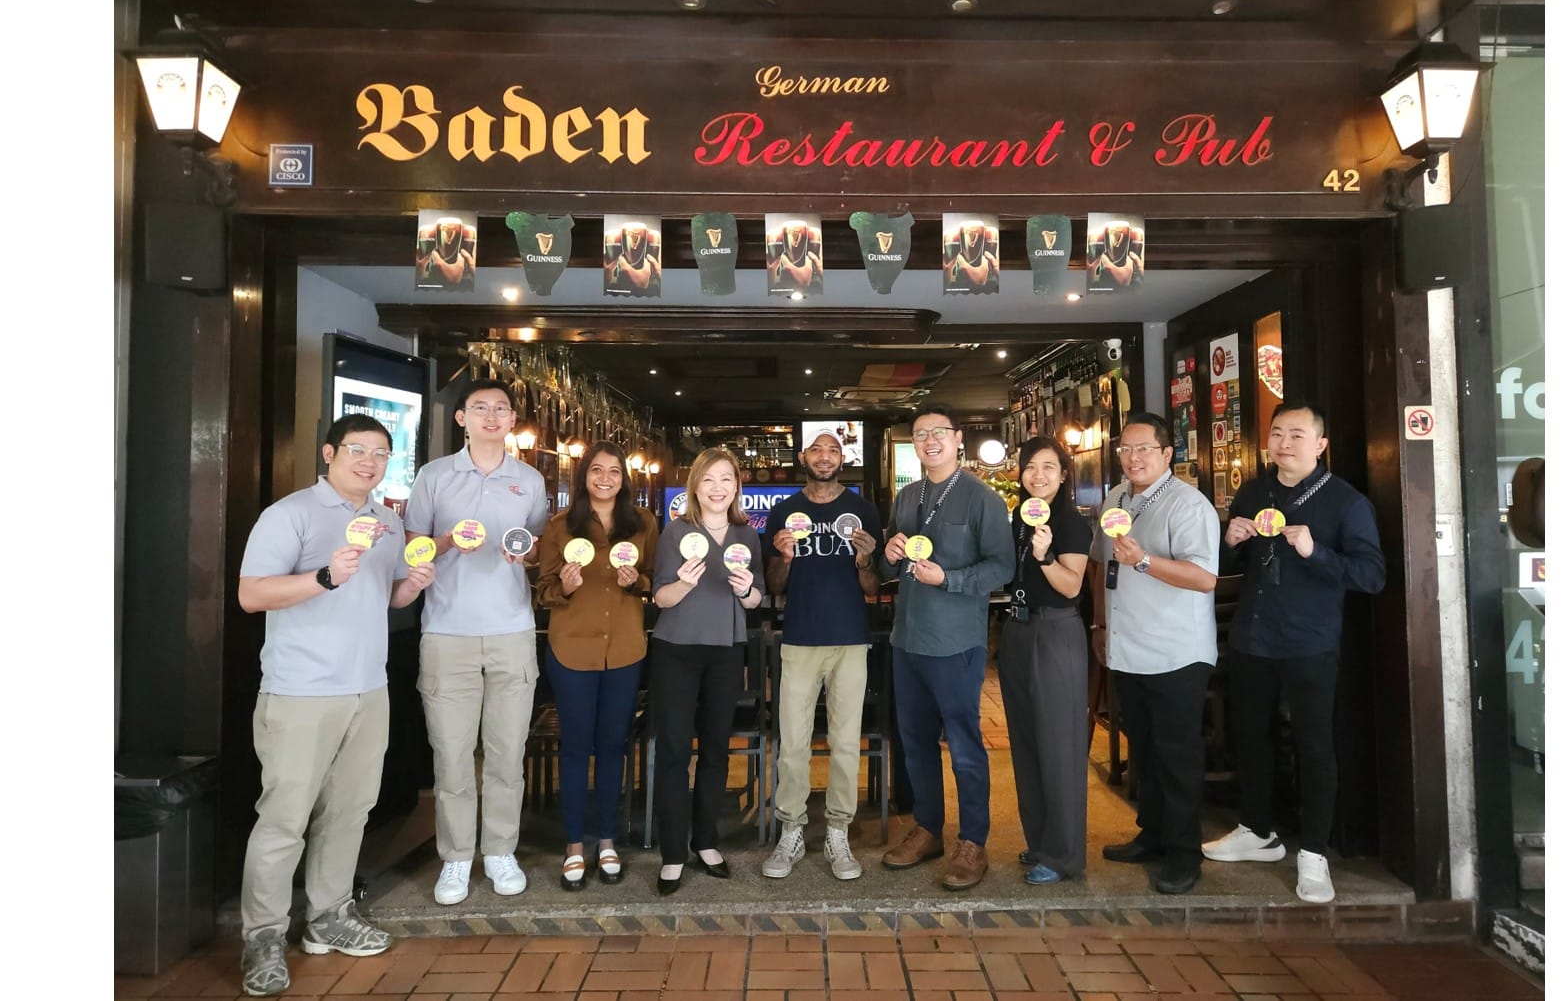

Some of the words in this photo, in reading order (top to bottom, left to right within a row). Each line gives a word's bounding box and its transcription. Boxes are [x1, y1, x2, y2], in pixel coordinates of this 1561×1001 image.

[755, 65, 890, 98] German
[355, 82, 653, 165] Baden
[694, 112, 1066, 168] Restaurant
[1088, 120, 1136, 168] &
[1155, 113, 1275, 167] Pub
[276, 172, 306, 181] CISCO
[1322, 168, 1361, 193] 42
[700, 247, 732, 256] GUINNESS
[1034, 249, 1065, 257] GUINNESS
[526, 253, 563, 264] GUINNESS
[867, 253, 902, 262] GUINNESS
